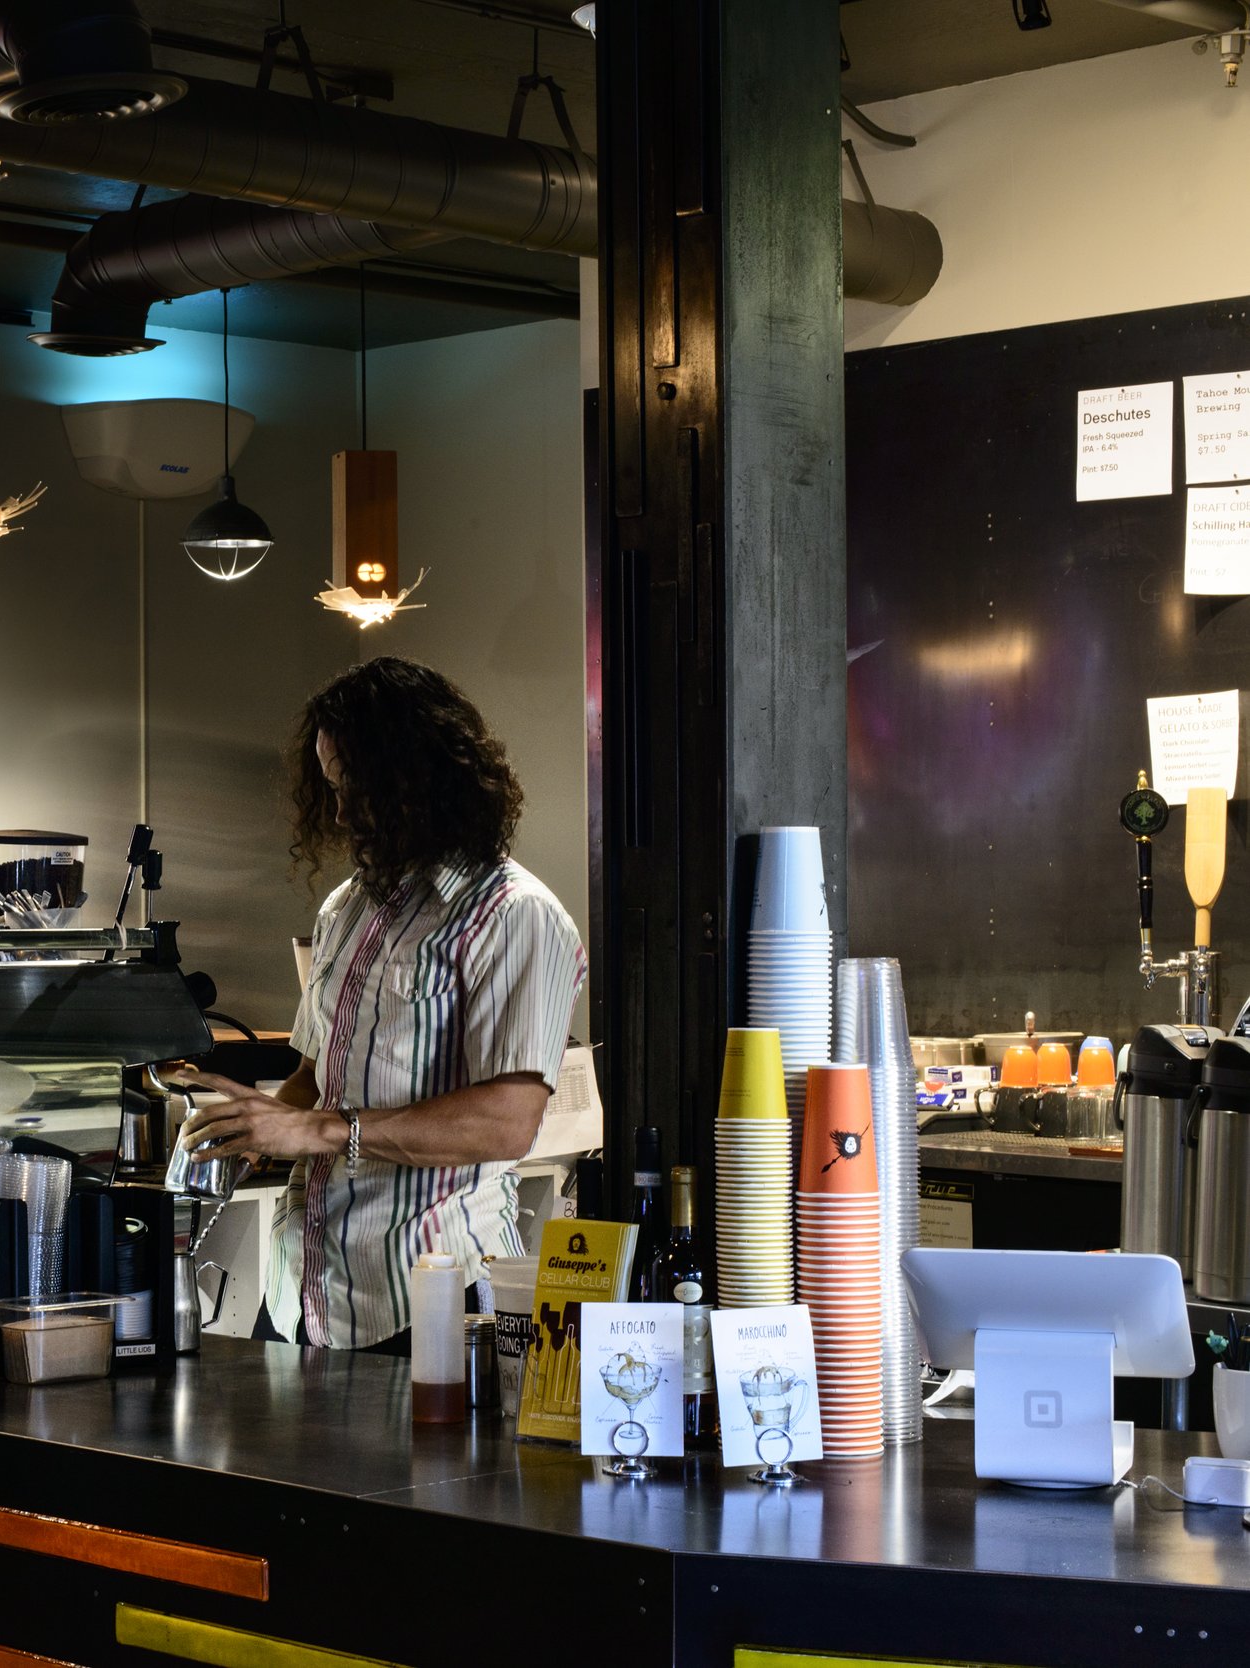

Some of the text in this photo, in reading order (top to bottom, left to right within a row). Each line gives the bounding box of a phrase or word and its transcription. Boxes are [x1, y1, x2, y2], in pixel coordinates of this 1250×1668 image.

[1083, 391, 1143, 406] DRAFT BEER
[1195, 388, 1228, 398] Tahoe
[1196, 402, 1241, 414] Brewing
[1083, 409, 1151, 425] Deschutes
[1082, 429, 1144, 442] Fresh Squeezed
[1197, 429, 1250, 443] Spring Sa
[1082, 445, 1094, 454] IPA
[1197, 444, 1226, 456] $7.50
[1193, 502, 1227, 513] DRAFT
[1192, 520, 1236, 532] Schilling
[1159, 721, 1200, 734] GELATO
[1202, 720, 1209, 731] &
[548, 1256, 607, 1274] Giuseppe's
[539, 1272, 610, 1289] CELLAR CLUB
[609, 1320, 657, 1335] AFFOCATO
[737, 1323, 788, 1341] MAROCCHINO
[117, 1347, 137, 1355] LITTLE
